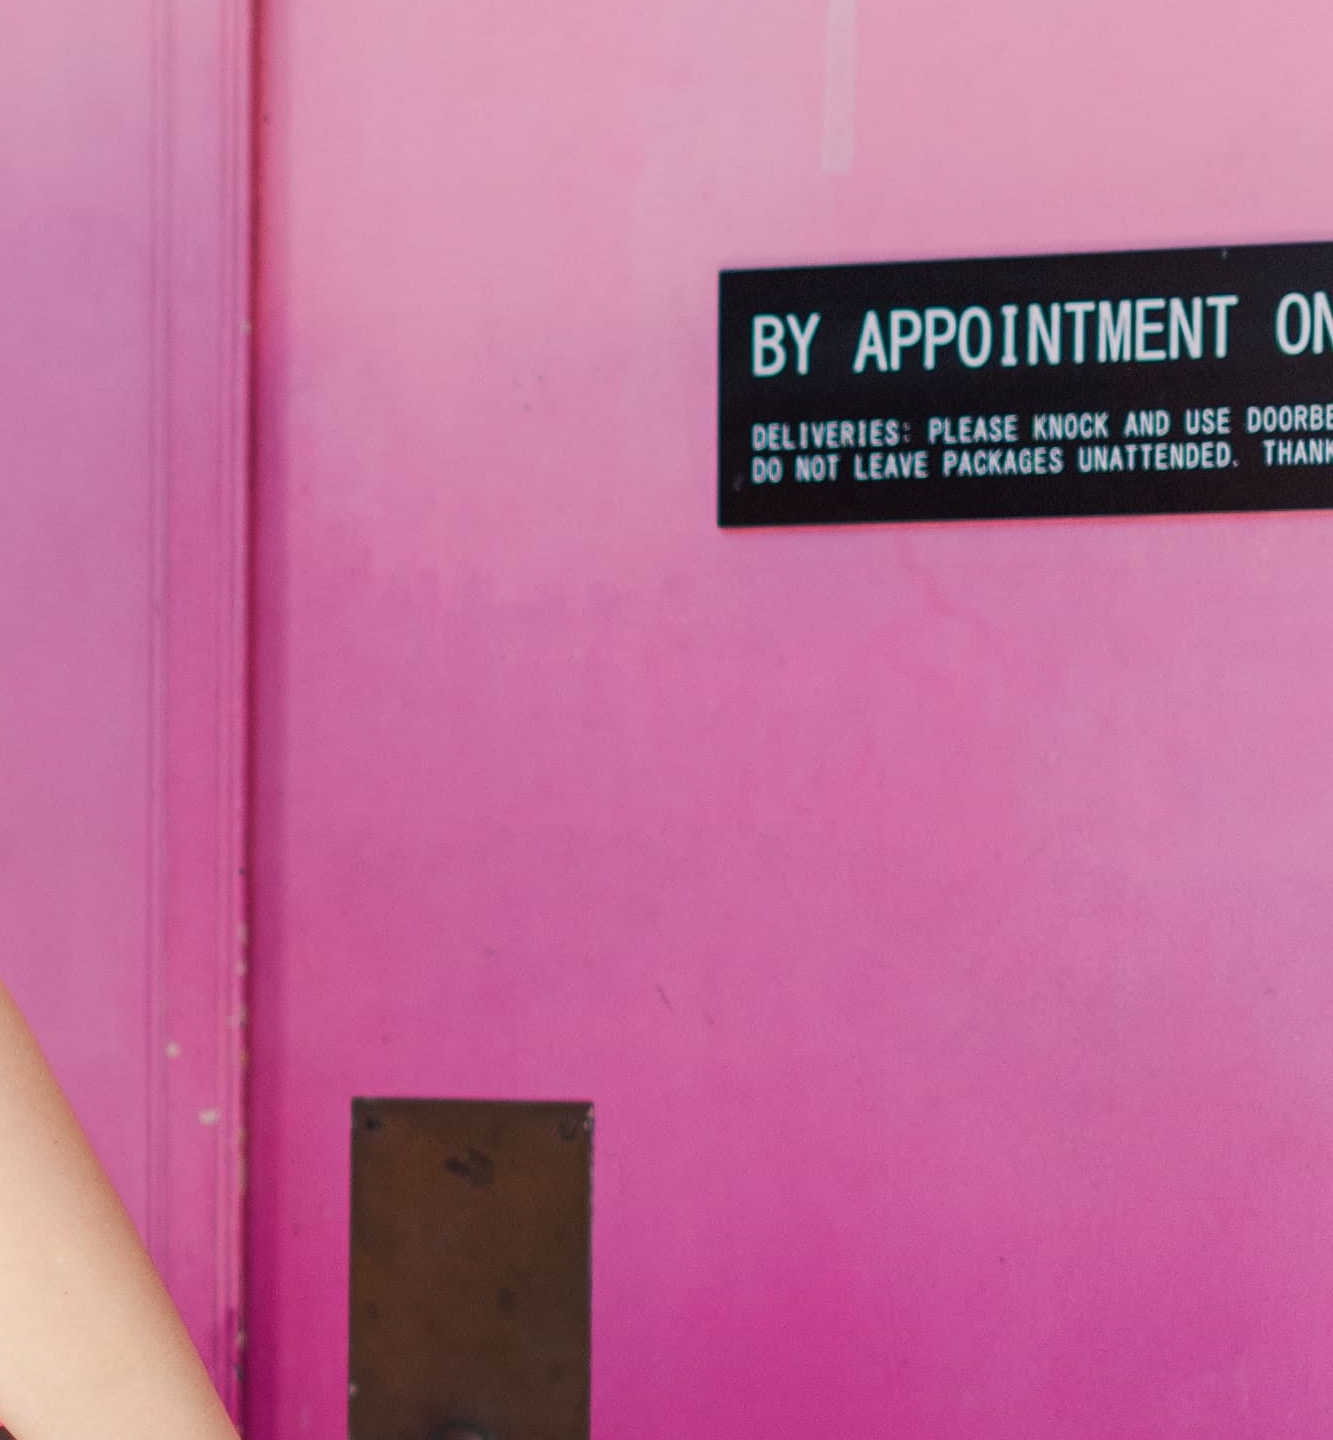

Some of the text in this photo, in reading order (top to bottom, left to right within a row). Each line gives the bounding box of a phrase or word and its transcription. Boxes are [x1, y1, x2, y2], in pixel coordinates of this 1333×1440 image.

[753, 313, 820, 376] BY
[853, 295, 1238, 373] APPOINTMENT
[753, 420, 908, 451] DELIVERIES:
[929, 415, 1017, 444] PLEASE
[1033, 412, 1108, 440] KNOCK
[1124, 410, 1170, 437] AND
[1186, 407, 1230, 435] USE
[753, 457, 782, 483] DO
[796, 454, 838, 481] NOT
[855, 451, 927, 480] LEAVE
[943, 447, 1063, 476] PACKAGES
[1079, 441, 1238, 472] UNATTENDED.
